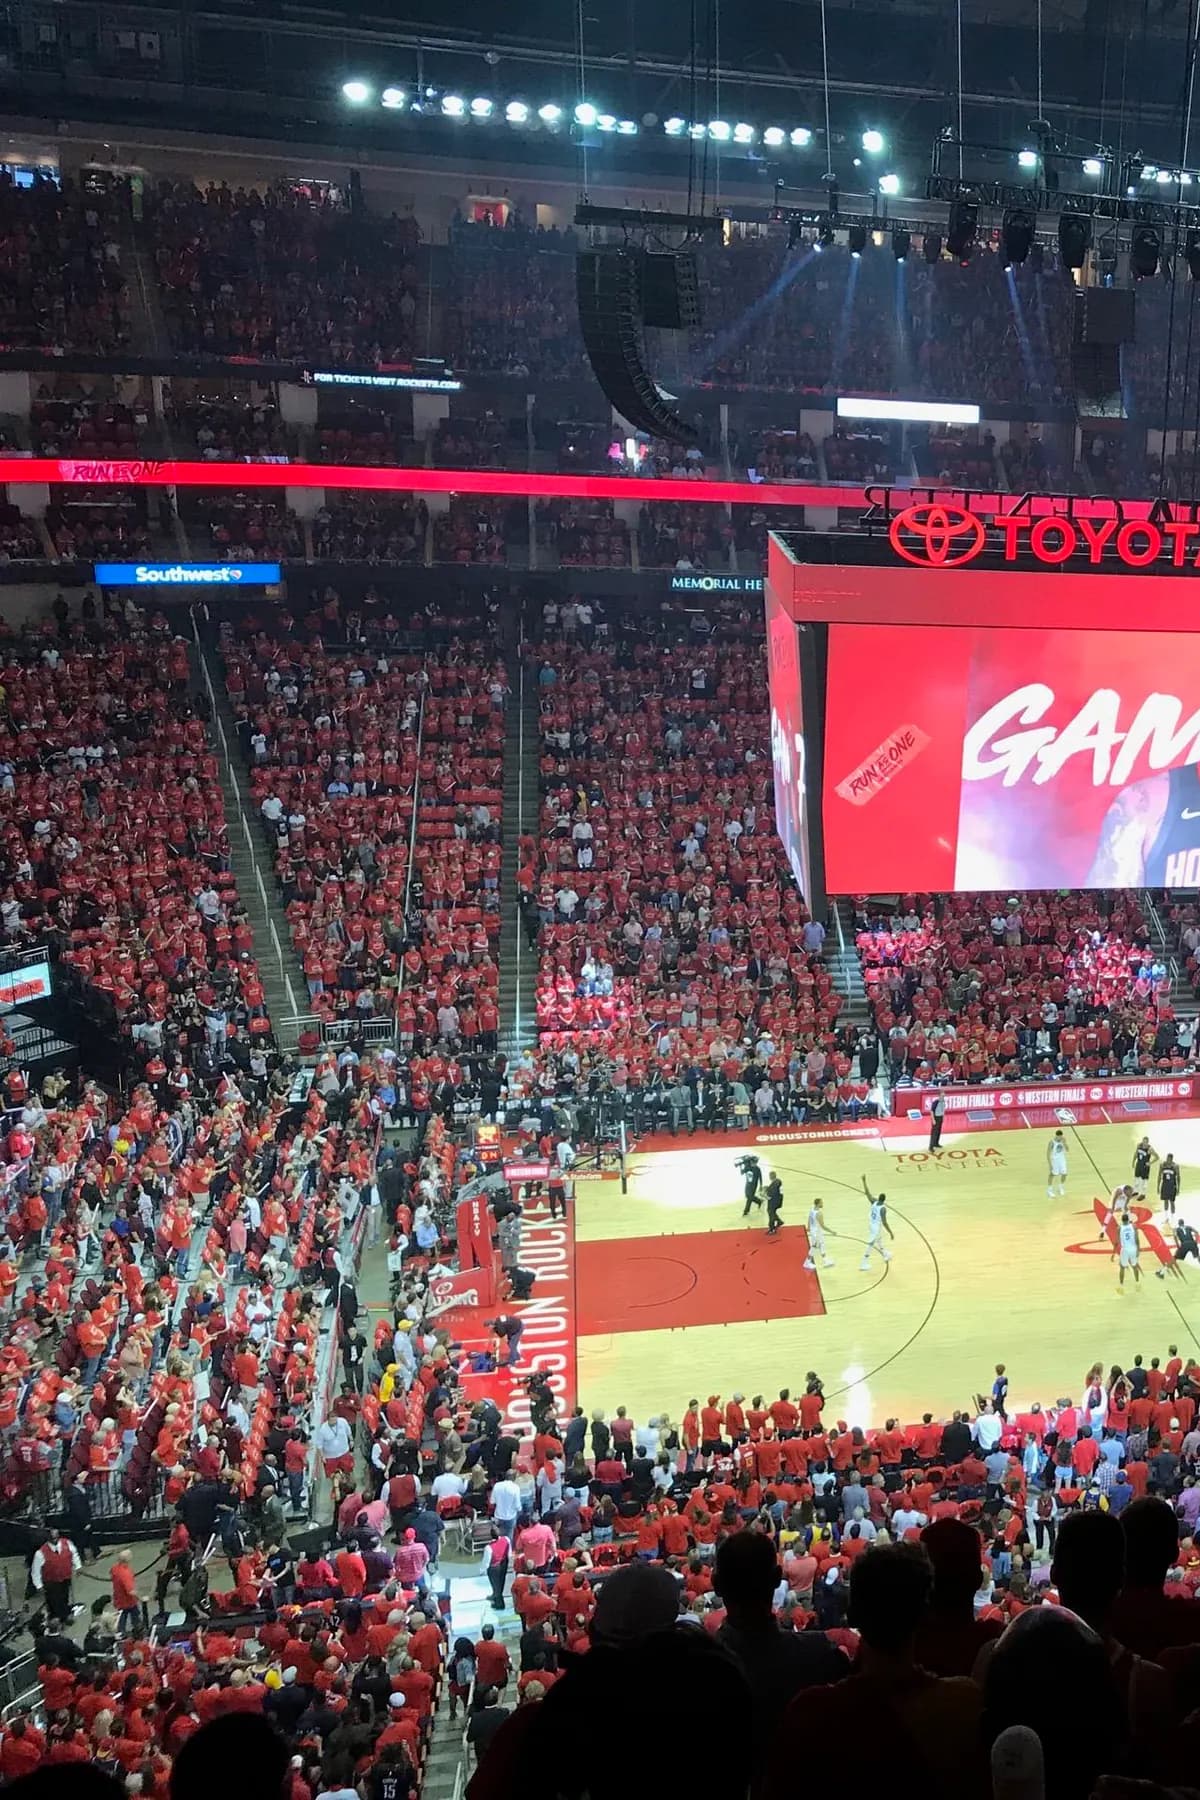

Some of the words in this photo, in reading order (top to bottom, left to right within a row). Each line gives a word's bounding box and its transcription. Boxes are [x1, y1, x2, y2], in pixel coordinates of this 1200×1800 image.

[313, 372, 333, 382] FOR
[334, 374, 371, 385] TICKETS
[372, 376, 397, 386] VISIT
[397, 377, 460, 389] ROCKETS.COM
[72, 464, 109, 481] RUN
[135, 566, 230, 583] Southwest
[671, 577, 742, 591] MEMORIAL
[849, 765, 878, 797] RUN
[888, 731, 916, 762] ONE
[1025, 1089, 1058, 1105] WESTERN
[1060, 1087, 1086, 1102] FINALS
[1115, 1084, 1148, 1099] WESTERN
[1149, 1082, 1174, 1097] FINALS
[969, 1092, 996, 1108] FINALS
[891, 1147, 1002, 1163] TOYOTA
[895, 1158, 1009, 1175] CENTER
[383, 1784, 396, 1799] 15
